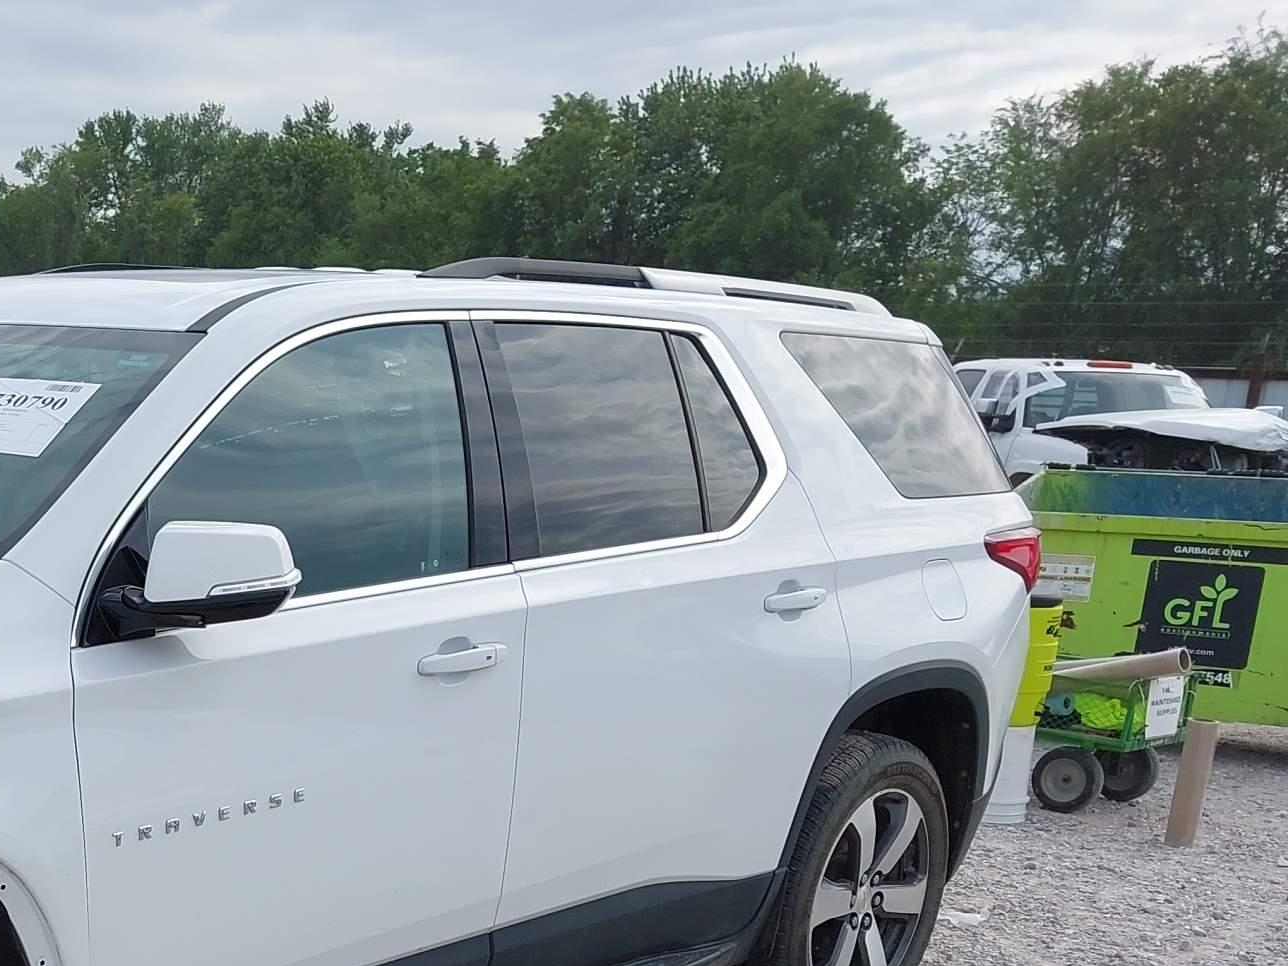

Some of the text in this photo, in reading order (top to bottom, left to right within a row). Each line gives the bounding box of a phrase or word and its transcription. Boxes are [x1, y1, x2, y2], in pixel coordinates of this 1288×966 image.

[1174, 545, 1250, 558] GARBAGE ONLY
[1164, 592, 1230, 629] GFL
[112, 787, 306, 847] TRAVERSE
